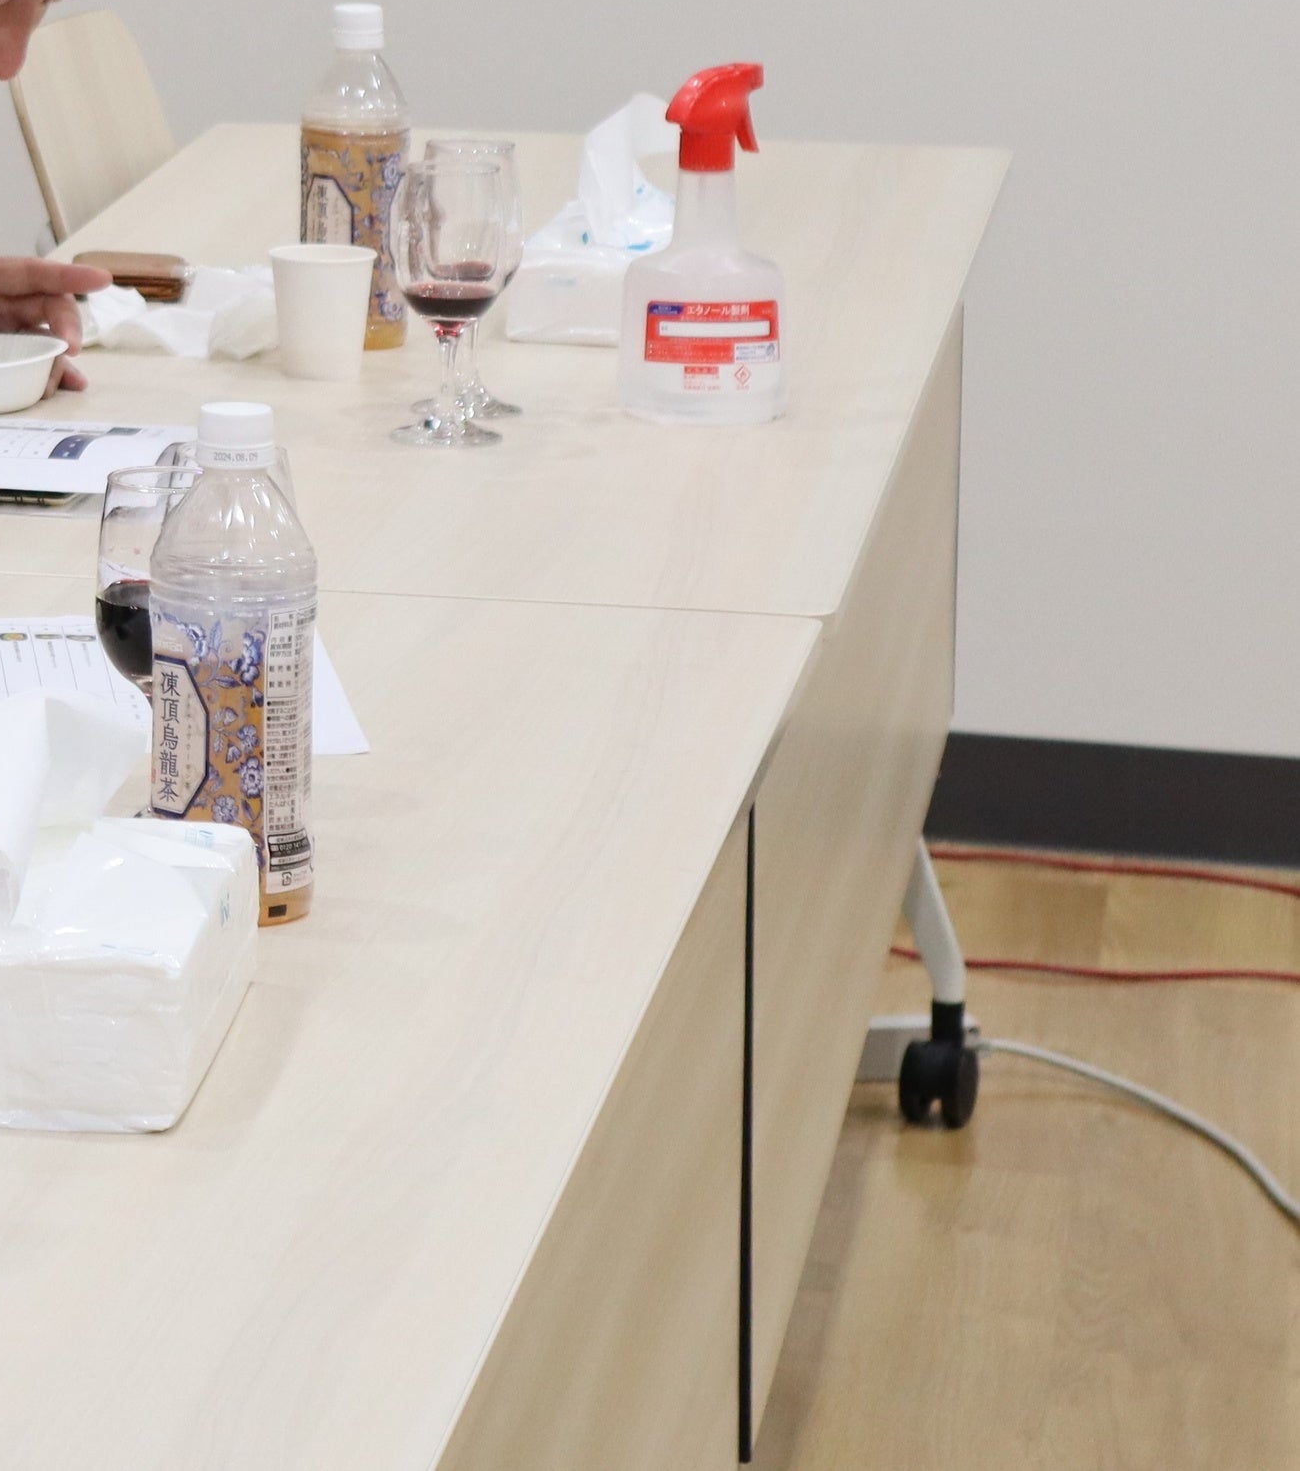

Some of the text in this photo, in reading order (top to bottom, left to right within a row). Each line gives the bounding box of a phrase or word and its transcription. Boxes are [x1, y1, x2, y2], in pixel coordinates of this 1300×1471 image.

[158, 671, 181, 803] 凍頂烏龍茶
